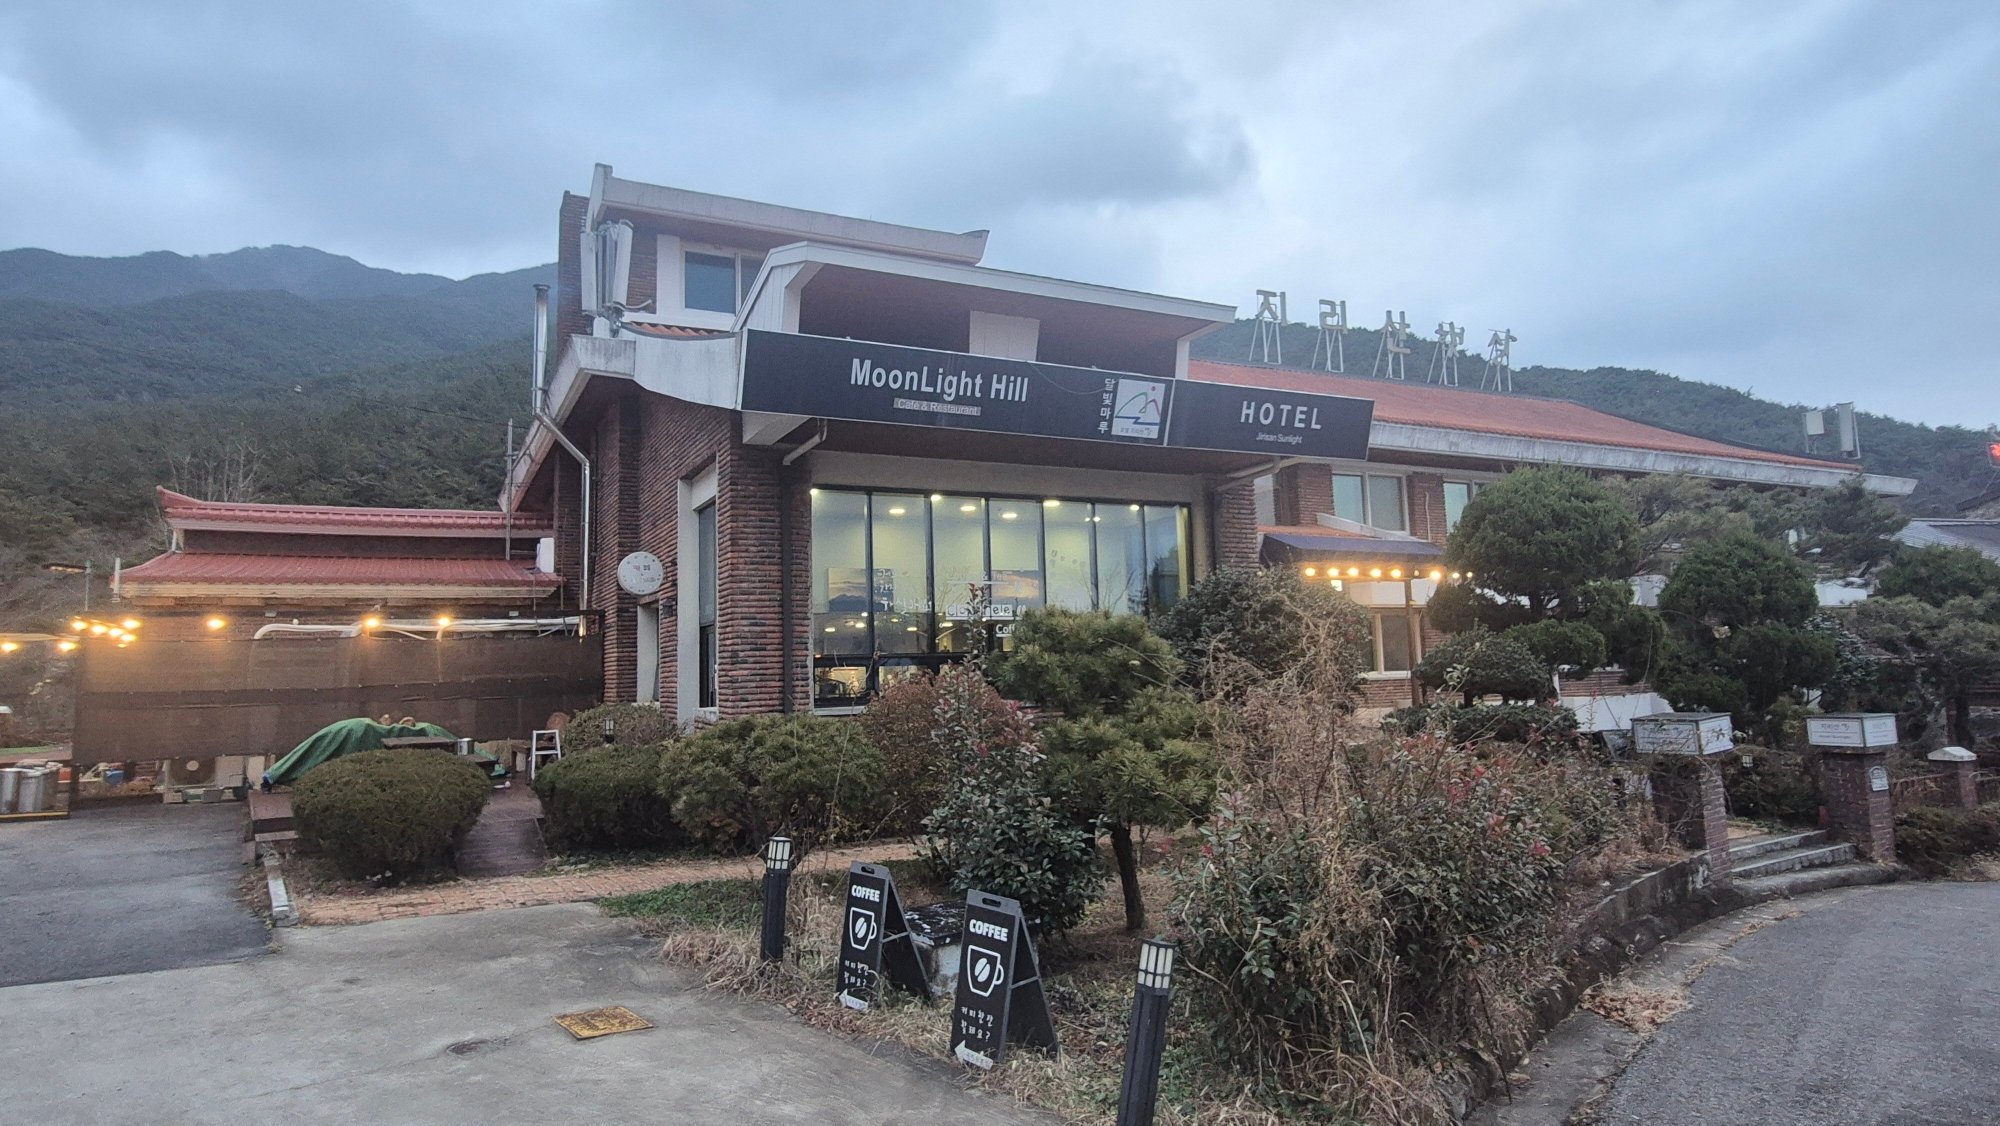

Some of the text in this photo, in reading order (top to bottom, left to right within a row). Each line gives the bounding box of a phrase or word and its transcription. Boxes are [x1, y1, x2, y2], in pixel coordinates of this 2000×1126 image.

[850, 358, 1029, 402] MoonLight Hill
[921, 403, 928, 411] &
[930, 402, 978, 416] Restaurant
[1097, 378, 1117, 435] 달빛마루
[1240, 400, 1322, 430] HOTEL
[851, 884, 881, 903] COFFEE
[969, 918, 1009, 942] COFFEE
